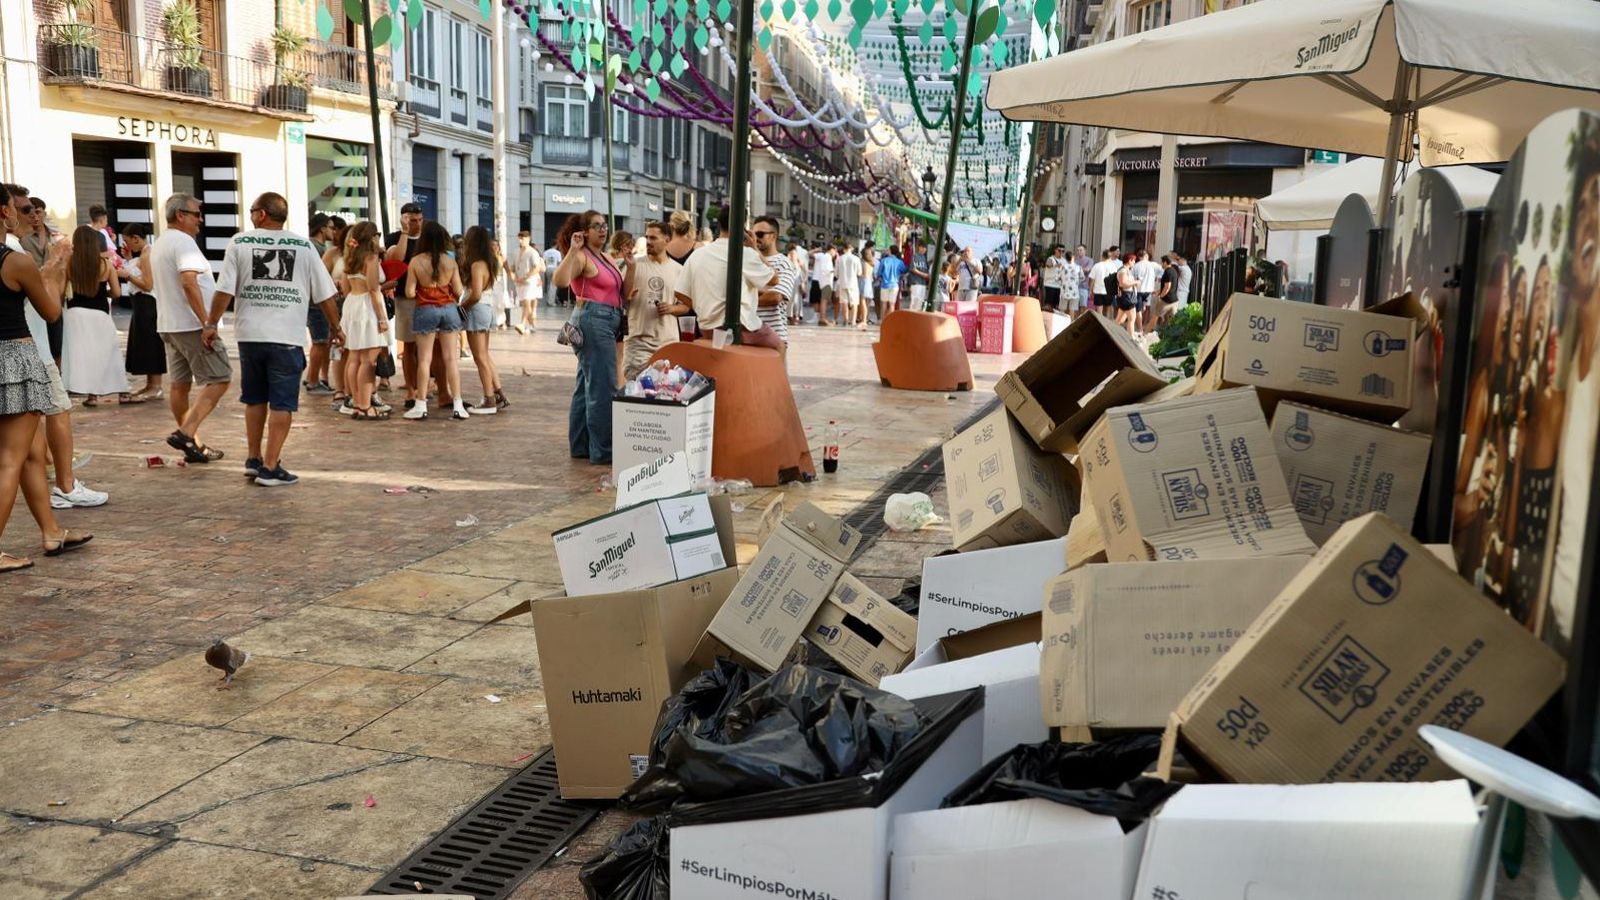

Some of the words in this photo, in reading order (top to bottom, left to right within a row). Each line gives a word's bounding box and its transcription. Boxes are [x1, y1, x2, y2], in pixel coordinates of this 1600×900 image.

[118, 116, 216, 147] SEPHORA
[1115, 158, 1161, 171] VICTORIA'S
[1174, 157, 1207, 168] SECRET
[234, 236, 275, 245] SONIC
[277, 238, 312, 250] AREA
[262, 286, 300, 296] RHYTHMS
[264, 293, 302, 304] HORIZONS
[1248, 315, 1276, 332] 50cl
[1252, 332, 1270, 344] x20
[632, 444, 662, 454] GRACIAS
[1200, 431, 1220, 480] ENVASES
[1205, 413, 1233, 484] SOSTENIBLES
[1237, 435, 1257, 482] RECICLADO
[1215, 481, 1225, 497] EN
[1344, 454, 1363, 500] ENVASES
[1220, 499, 1245, 545] CREEMOS
[814, 560, 832, 581] 50cl
[746, 590, 767, 624] SOSTENIBLES
[757, 596, 774, 619] ENVASES
[1144, 632, 1194, 641] derecho
[1191, 645, 1210, 657] del
[572, 688, 642, 704] Huhtamaki
[1374, 725, 1402, 755] MÁS
[1402, 638, 1485, 726] SOSTENIBLES
[1376, 706, 1397, 726] EN
[1395, 646, 1452, 706] ENVASES
[1440, 689, 1475, 720] 100%
[1216, 696, 1261, 742] 50cl
[1246, 721, 1271, 750] x20
[1385, 748, 1419, 779] 100%
